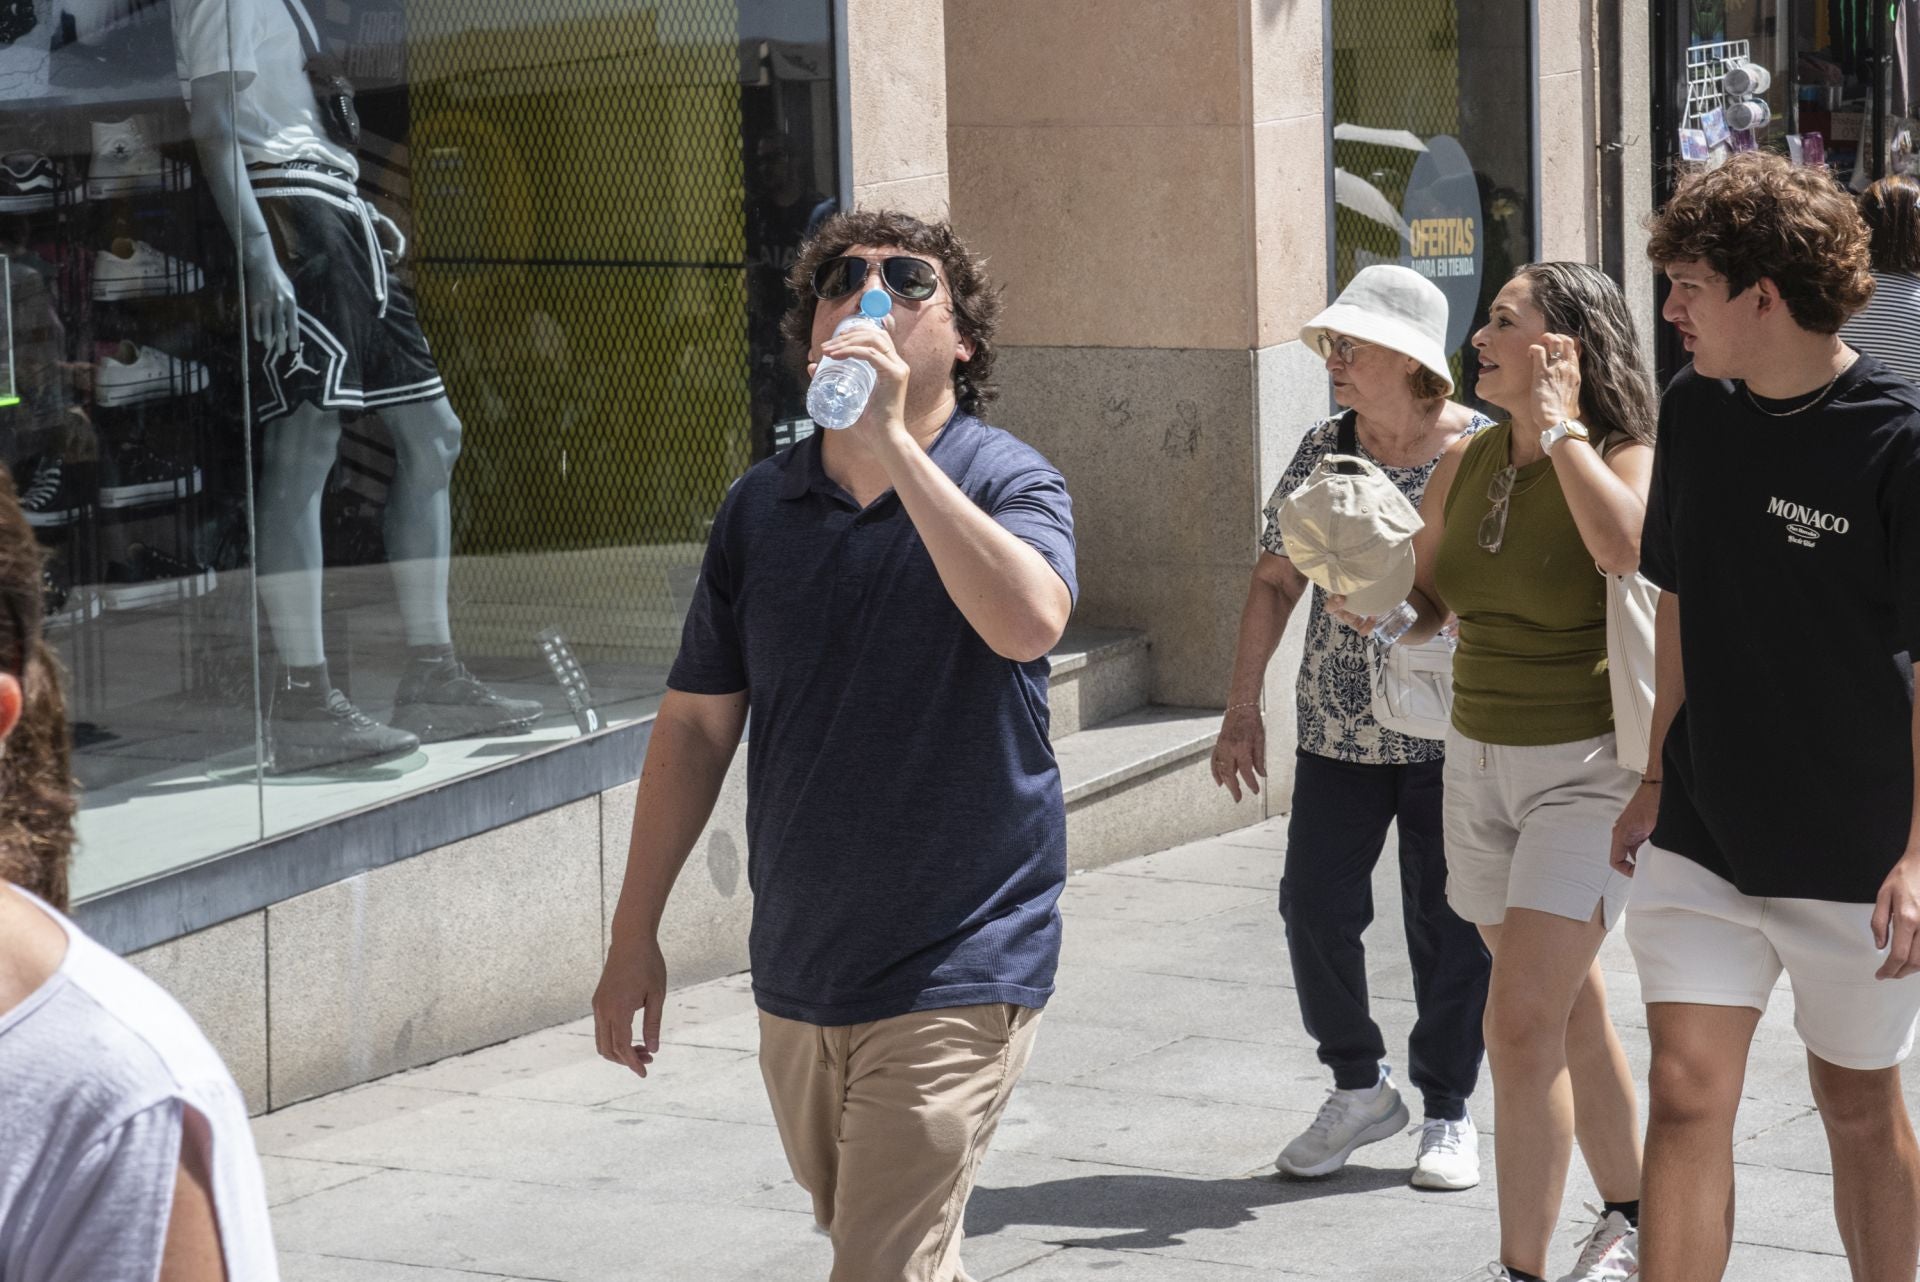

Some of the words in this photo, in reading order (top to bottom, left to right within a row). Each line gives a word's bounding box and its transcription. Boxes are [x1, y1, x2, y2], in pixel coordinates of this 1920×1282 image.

[280, 161, 318, 172] NIKE
[1410, 217, 1475, 258] OFERTAS
[1437, 257, 1448, 277] EN
[1448, 257, 1475, 276] TIENDA
[1766, 496, 1849, 534] MONACO
